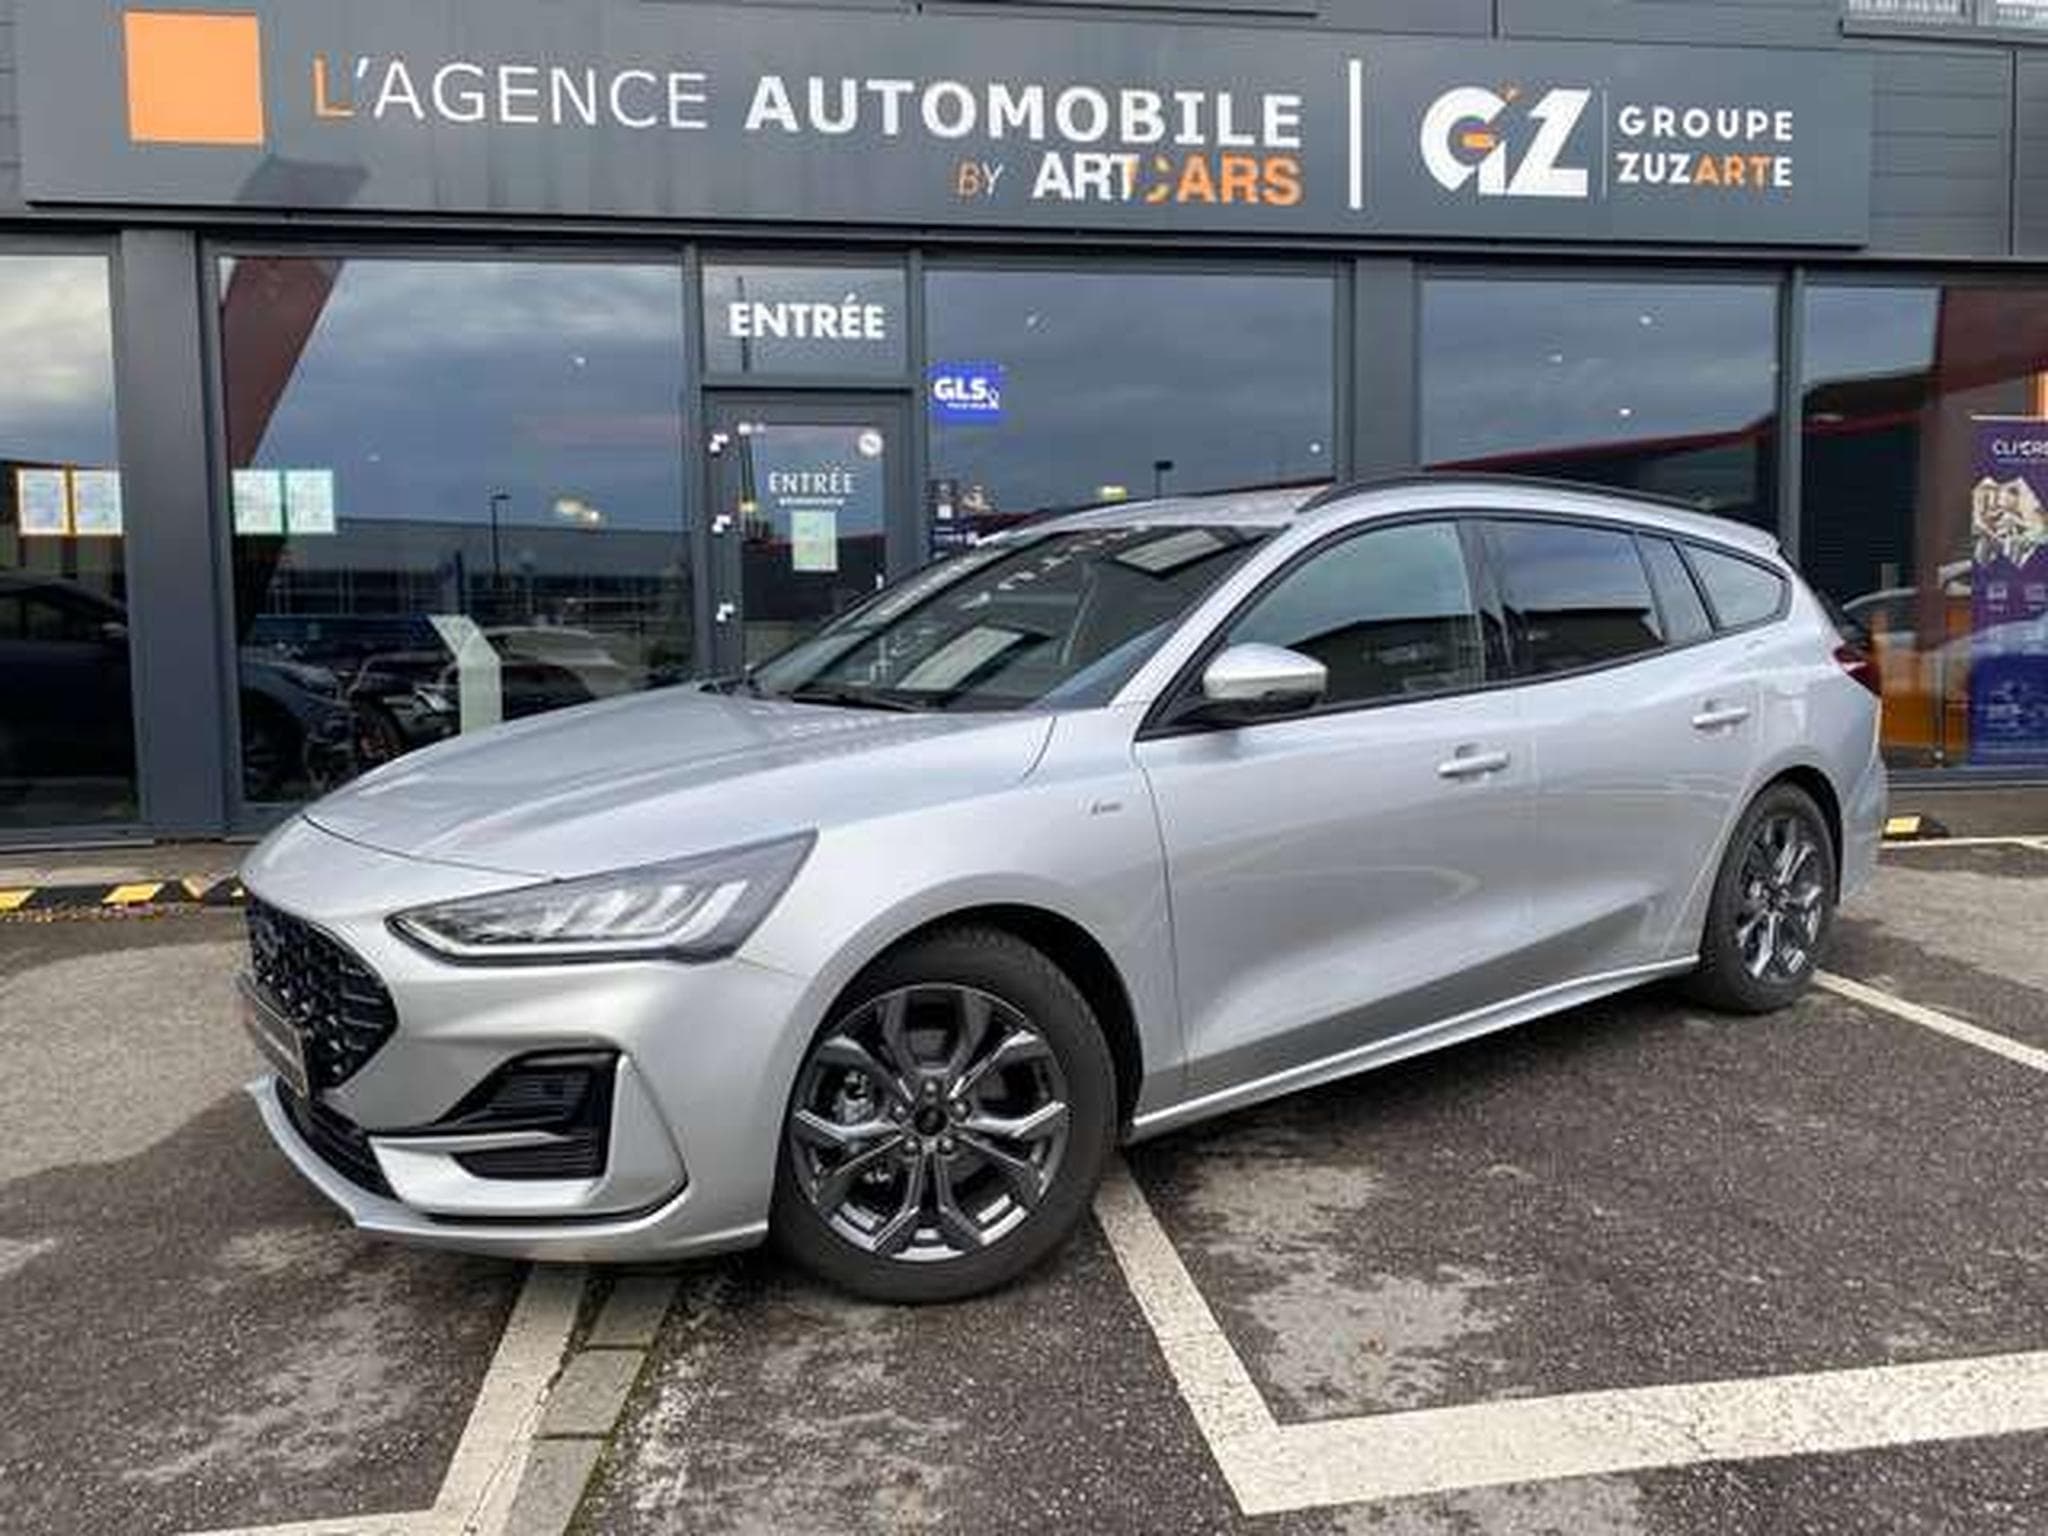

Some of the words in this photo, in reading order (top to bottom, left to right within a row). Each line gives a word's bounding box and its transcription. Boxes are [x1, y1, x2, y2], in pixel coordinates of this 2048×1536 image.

[313, 55, 708, 130] L'AGENCE
[743, 75, 1302, 148] AUTOMOBILE
[1618, 106, 1794, 141] GROUPE
[956, 160, 1003, 196] BY
[1617, 151, 1794, 188] ZUZARTE
[728, 293, 887, 340] ENTRÉE
[933, 377, 988, 401] GLS
[768, 466, 855, 495] ENTRÉE
